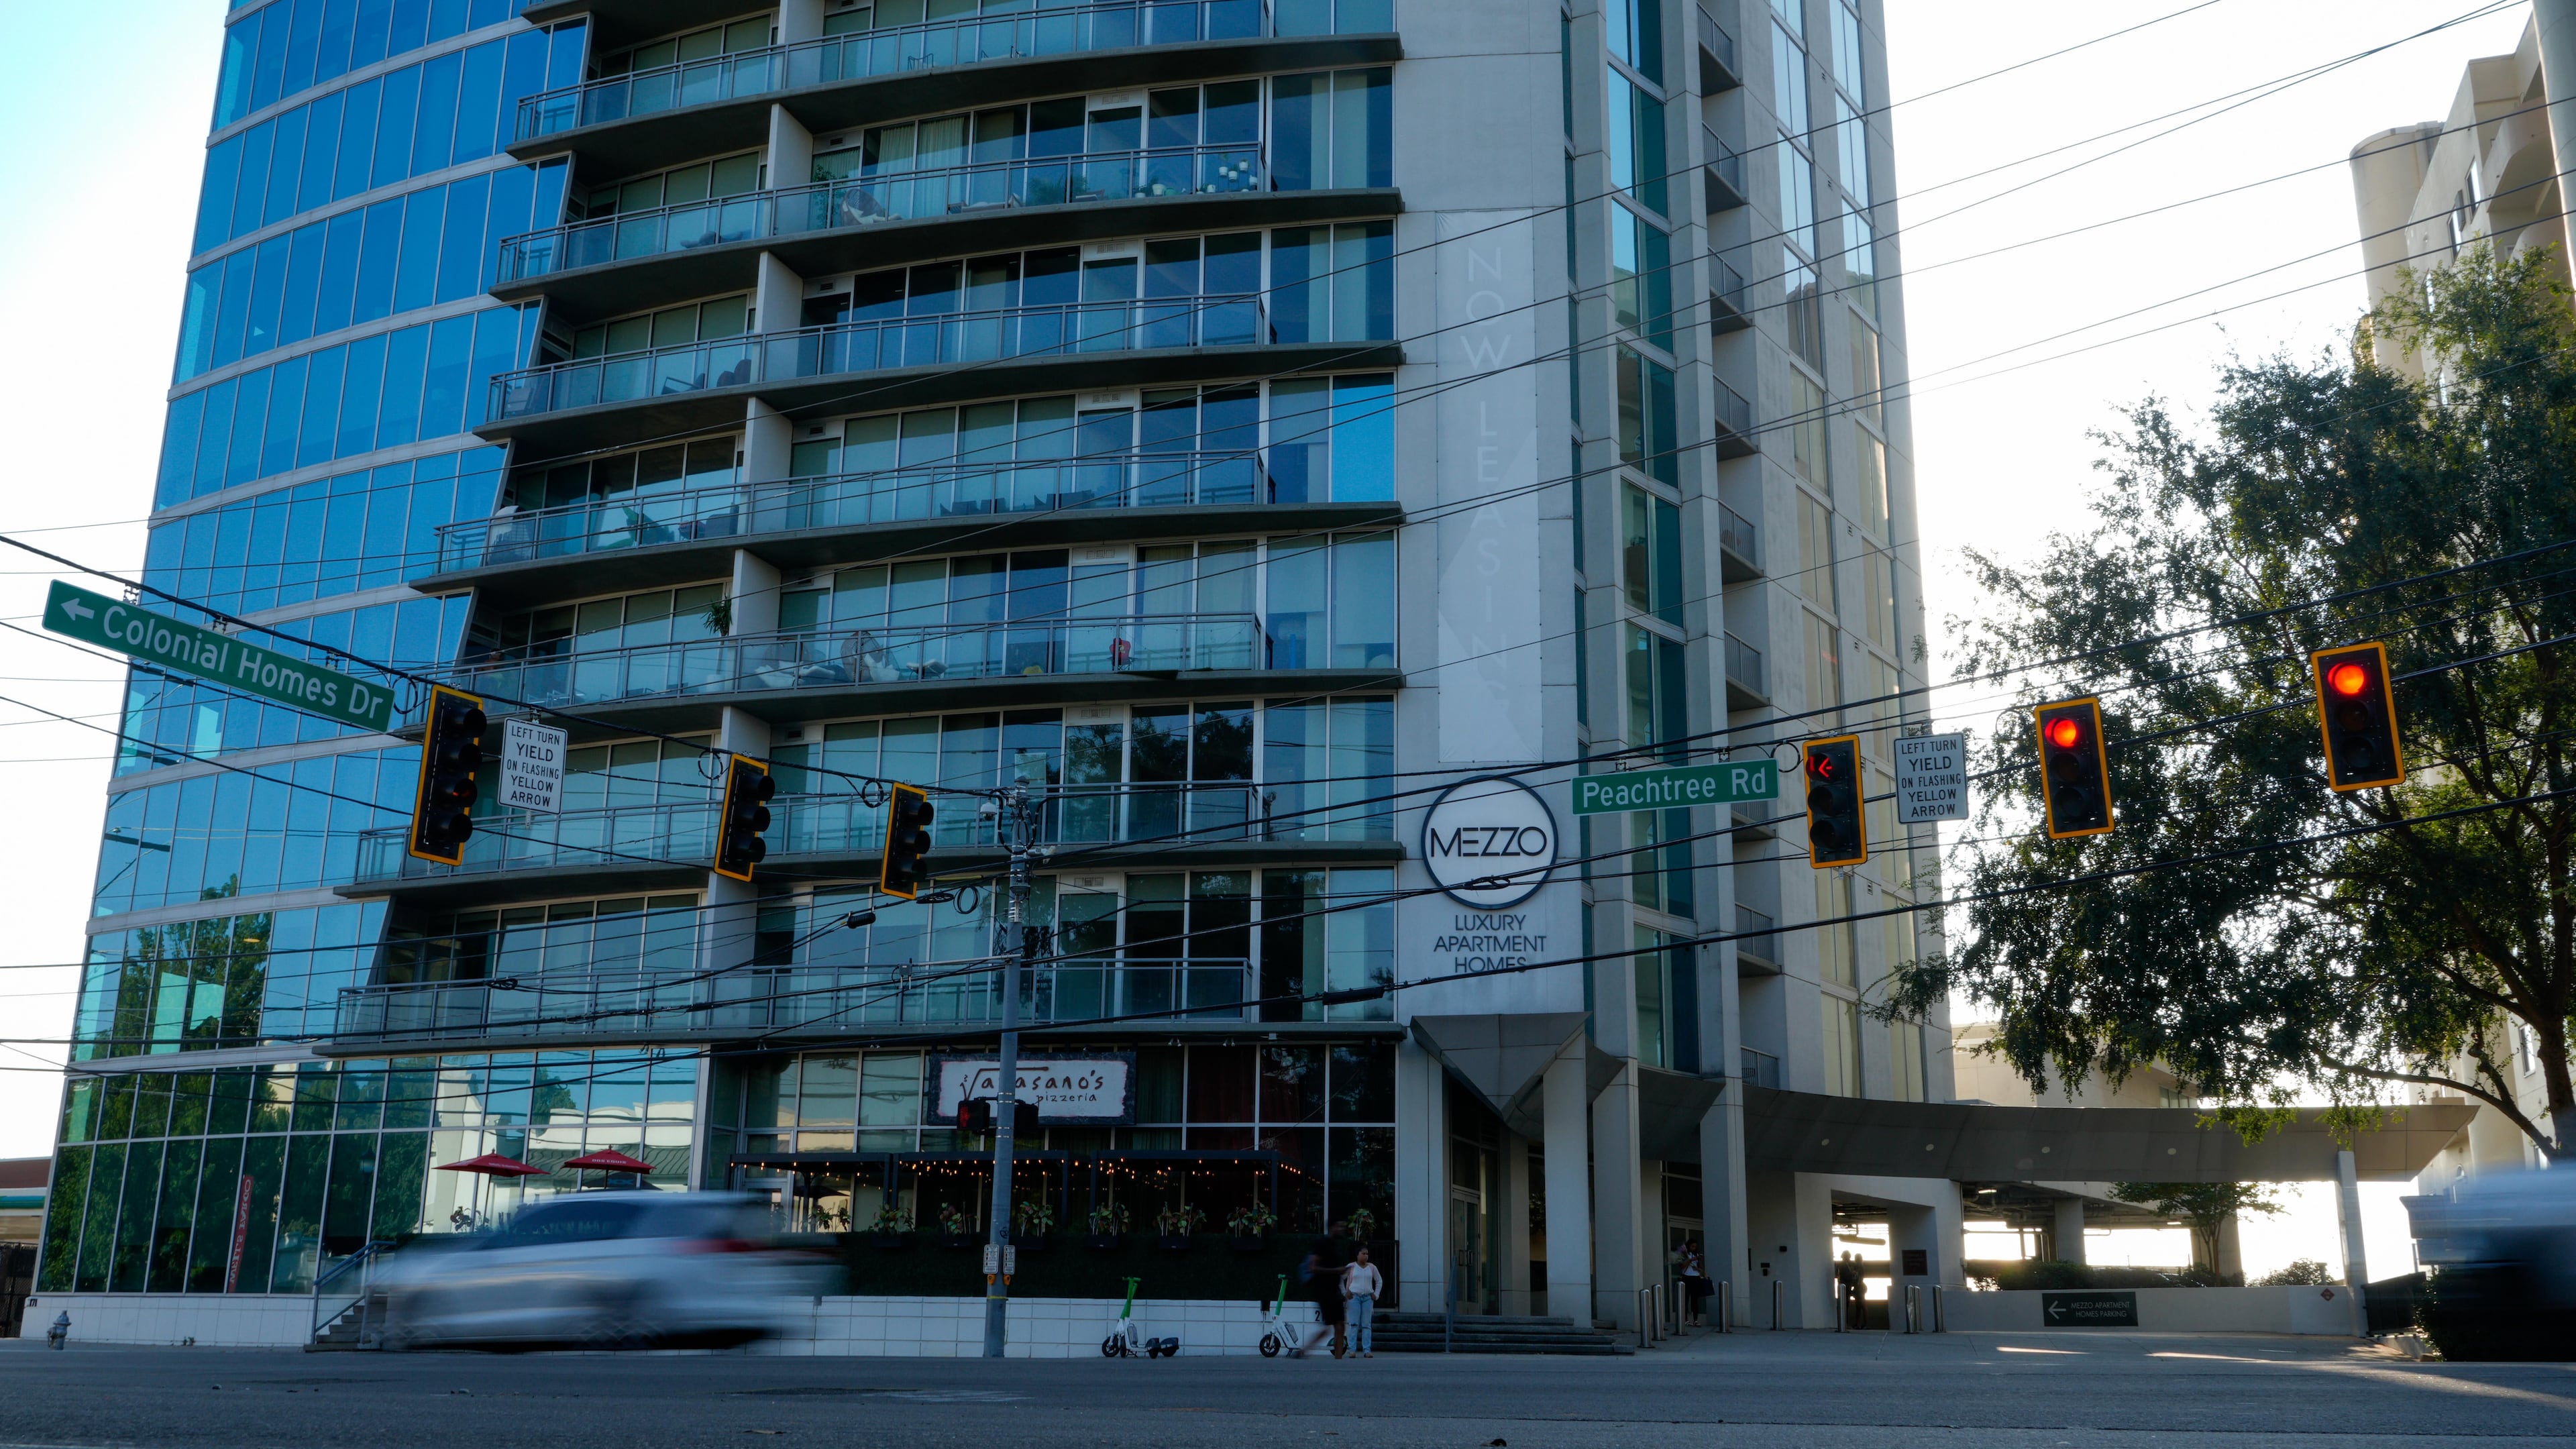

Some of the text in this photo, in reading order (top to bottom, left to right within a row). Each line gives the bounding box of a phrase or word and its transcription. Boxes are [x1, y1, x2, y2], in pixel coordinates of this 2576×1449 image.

[1460, 247, 1512, 371] NOW
[103, 605, 384, 719] Colonial Homes Dr
[511, 725, 560, 745] LEFT TURN
[516, 742, 553, 761] YIELD
[1901, 739, 1957, 755] LEFT TURN
[506, 759, 559, 780] ON FLASHING
[1909, 756, 1951, 771] YIELD
[511, 775, 553, 792] YELLOW
[1582, 767, 1766, 808] Peachtree Rd
[1902, 773, 1962, 789] ON FLASHING
[511, 790, 551, 807] ARROW
[1908, 788, 1956, 802] YELLOW
[1911, 804, 1955, 818] ARROW
[1430, 826, 1548, 857] MEZZO
[1455, 914, 1526, 931] LUXURY
[1433, 935, 1547, 952] APARTMENT
[1455, 957, 1527, 973] HOMES
[1037, 1092, 1097, 1106] pizzeria
